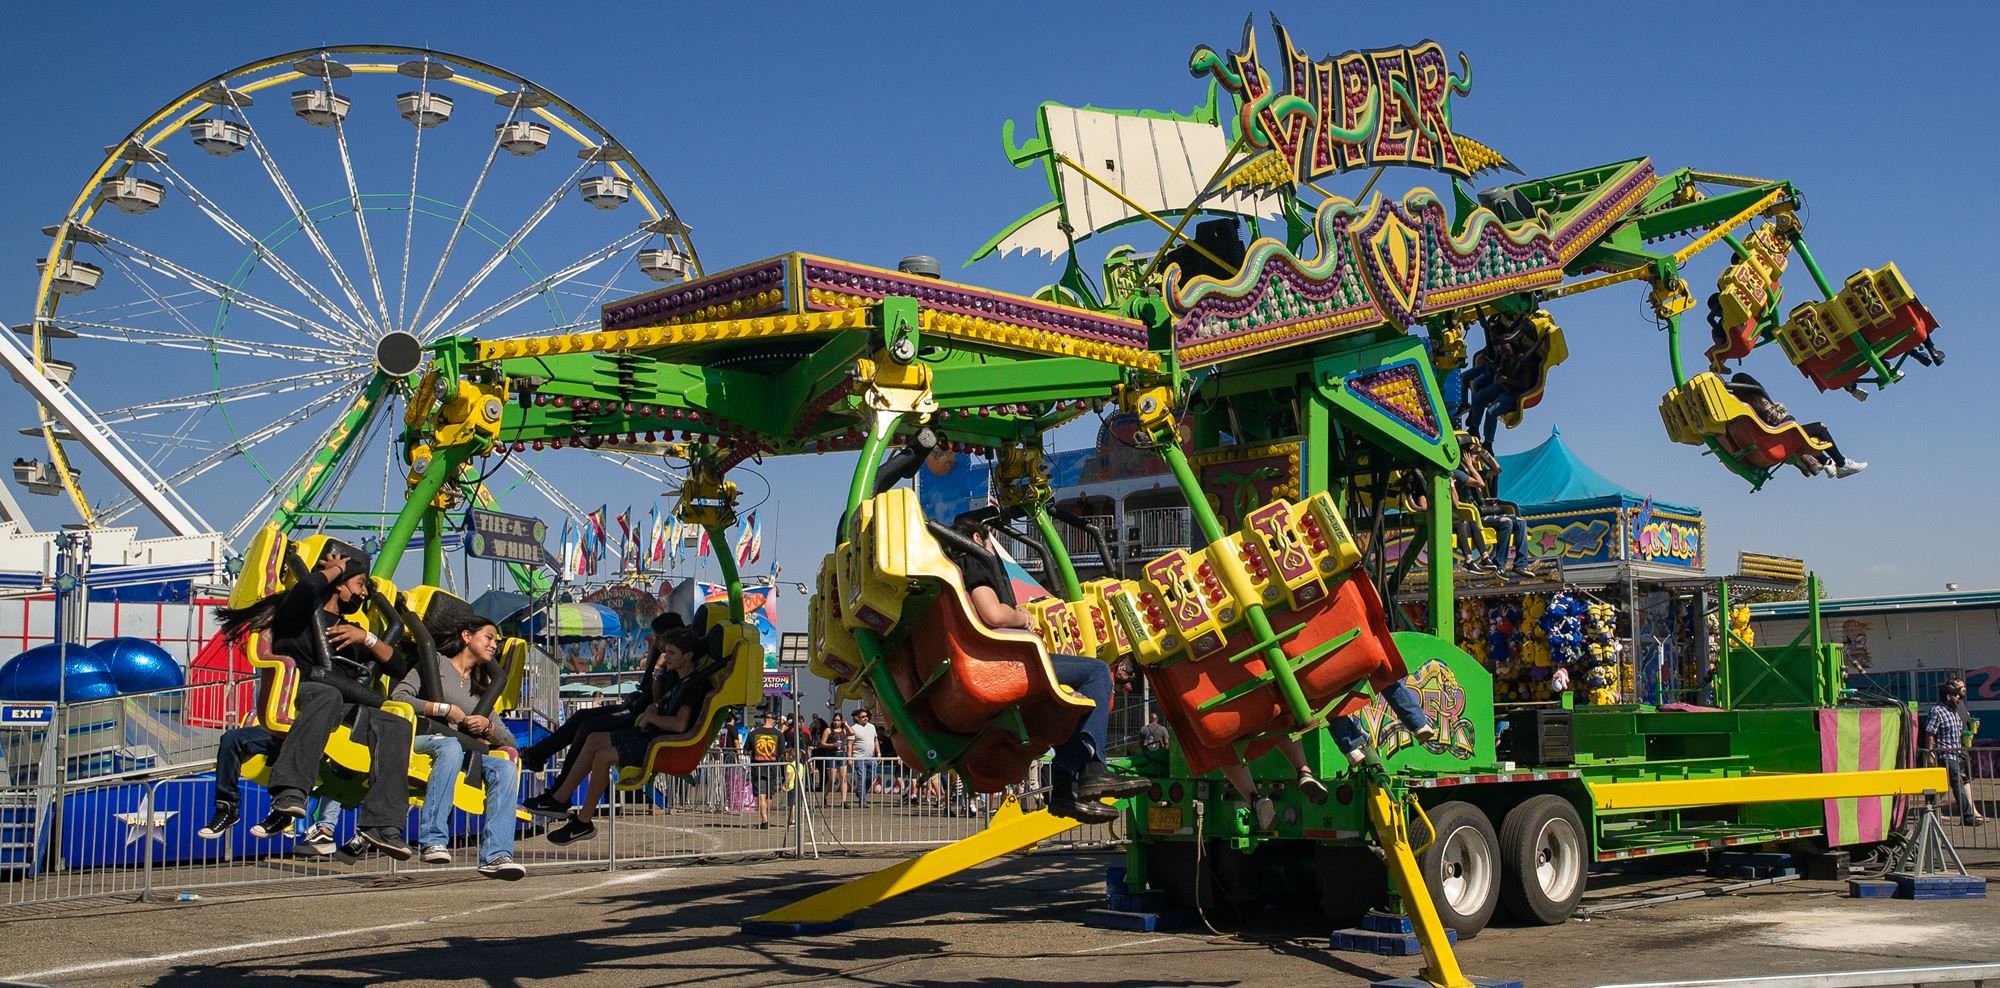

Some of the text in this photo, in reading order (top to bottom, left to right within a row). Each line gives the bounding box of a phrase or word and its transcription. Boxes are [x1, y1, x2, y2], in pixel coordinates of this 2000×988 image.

[1236, 11, 1471, 190] VIPER
[1319, 497, 1345, 541] VIPER
[493, 539, 540, 562] WHIRL
[1510, 520, 1609, 560] OX
[1640, 522, 1699, 560] TOY BOX
[607, 599, 624, 608] END
[1119, 595, 1145, 638] VIPER
[12, 709, 44, 719] EXIT
